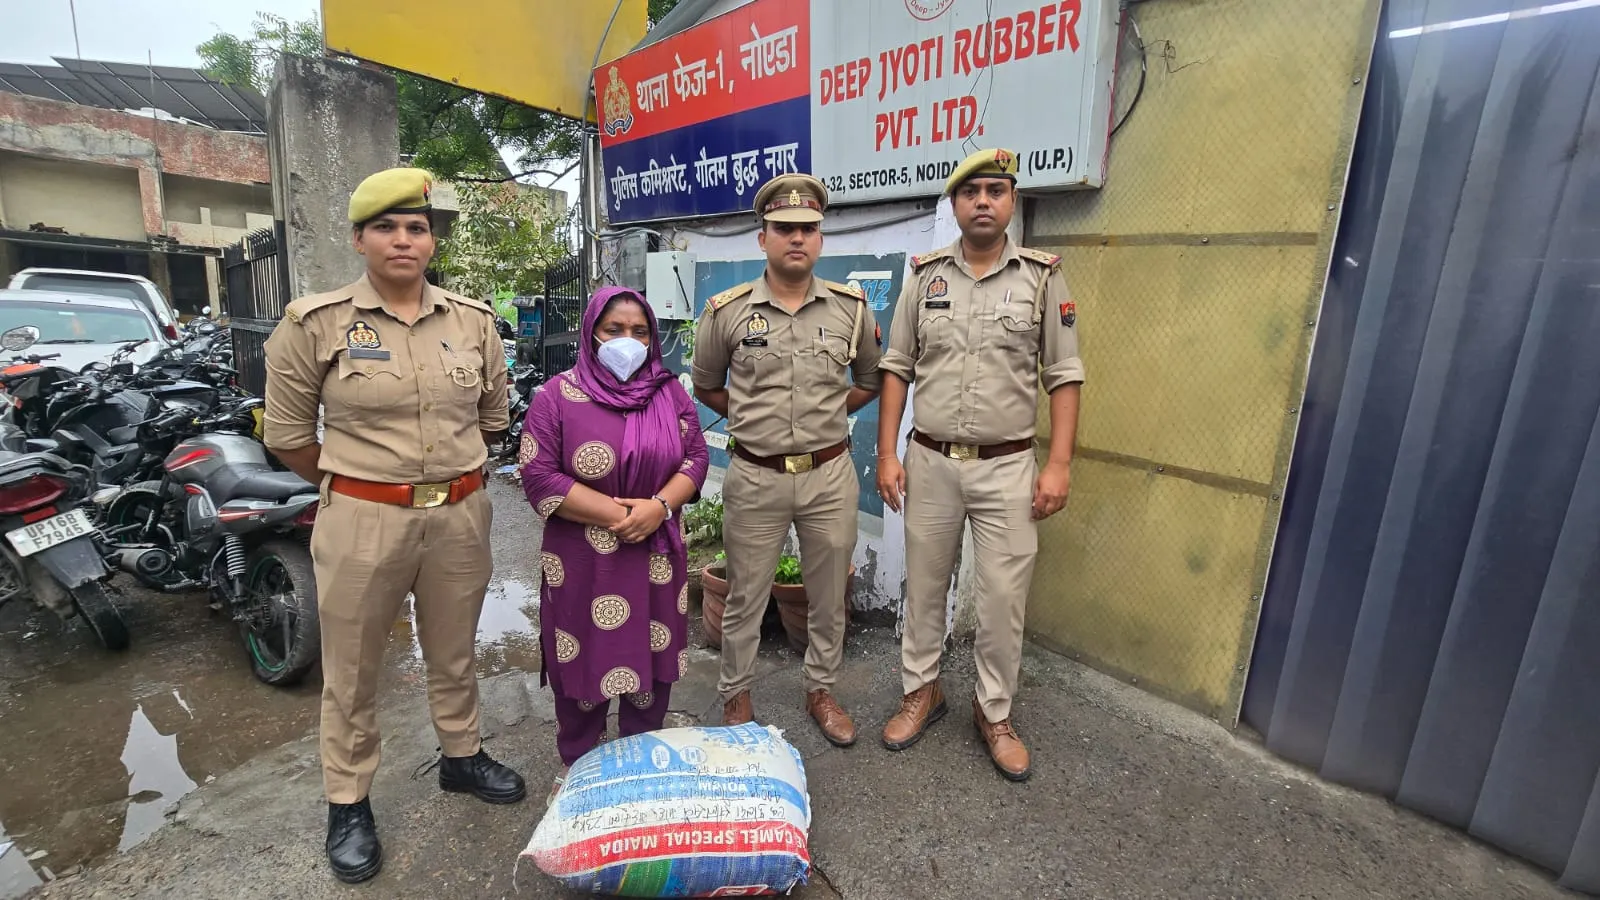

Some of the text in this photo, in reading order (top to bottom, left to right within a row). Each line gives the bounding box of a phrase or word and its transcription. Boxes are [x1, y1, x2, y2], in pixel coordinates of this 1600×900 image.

[636, 73, 669, 113] थाना
[740, 22, 799, 81] नोएडा
[819, 0, 1082, 106] DEEP JYOTI RUBBER
[875, 95, 984, 152] PVT. LTD.
[610, 166, 638, 211] पुलिस
[694, 146, 728, 189] गौतम
[732, 149, 760, 196] बुद्ध
[763, 142, 799, 175] नगर
[849, 167, 912, 190] SECTOR-5,
[1028, 147, 1073, 177] (U.P.)
[599, 834, 658, 857] MAIDA
[663, 829, 736, 847] SPECIAL
[740, 828, 793, 845] CAMEL
